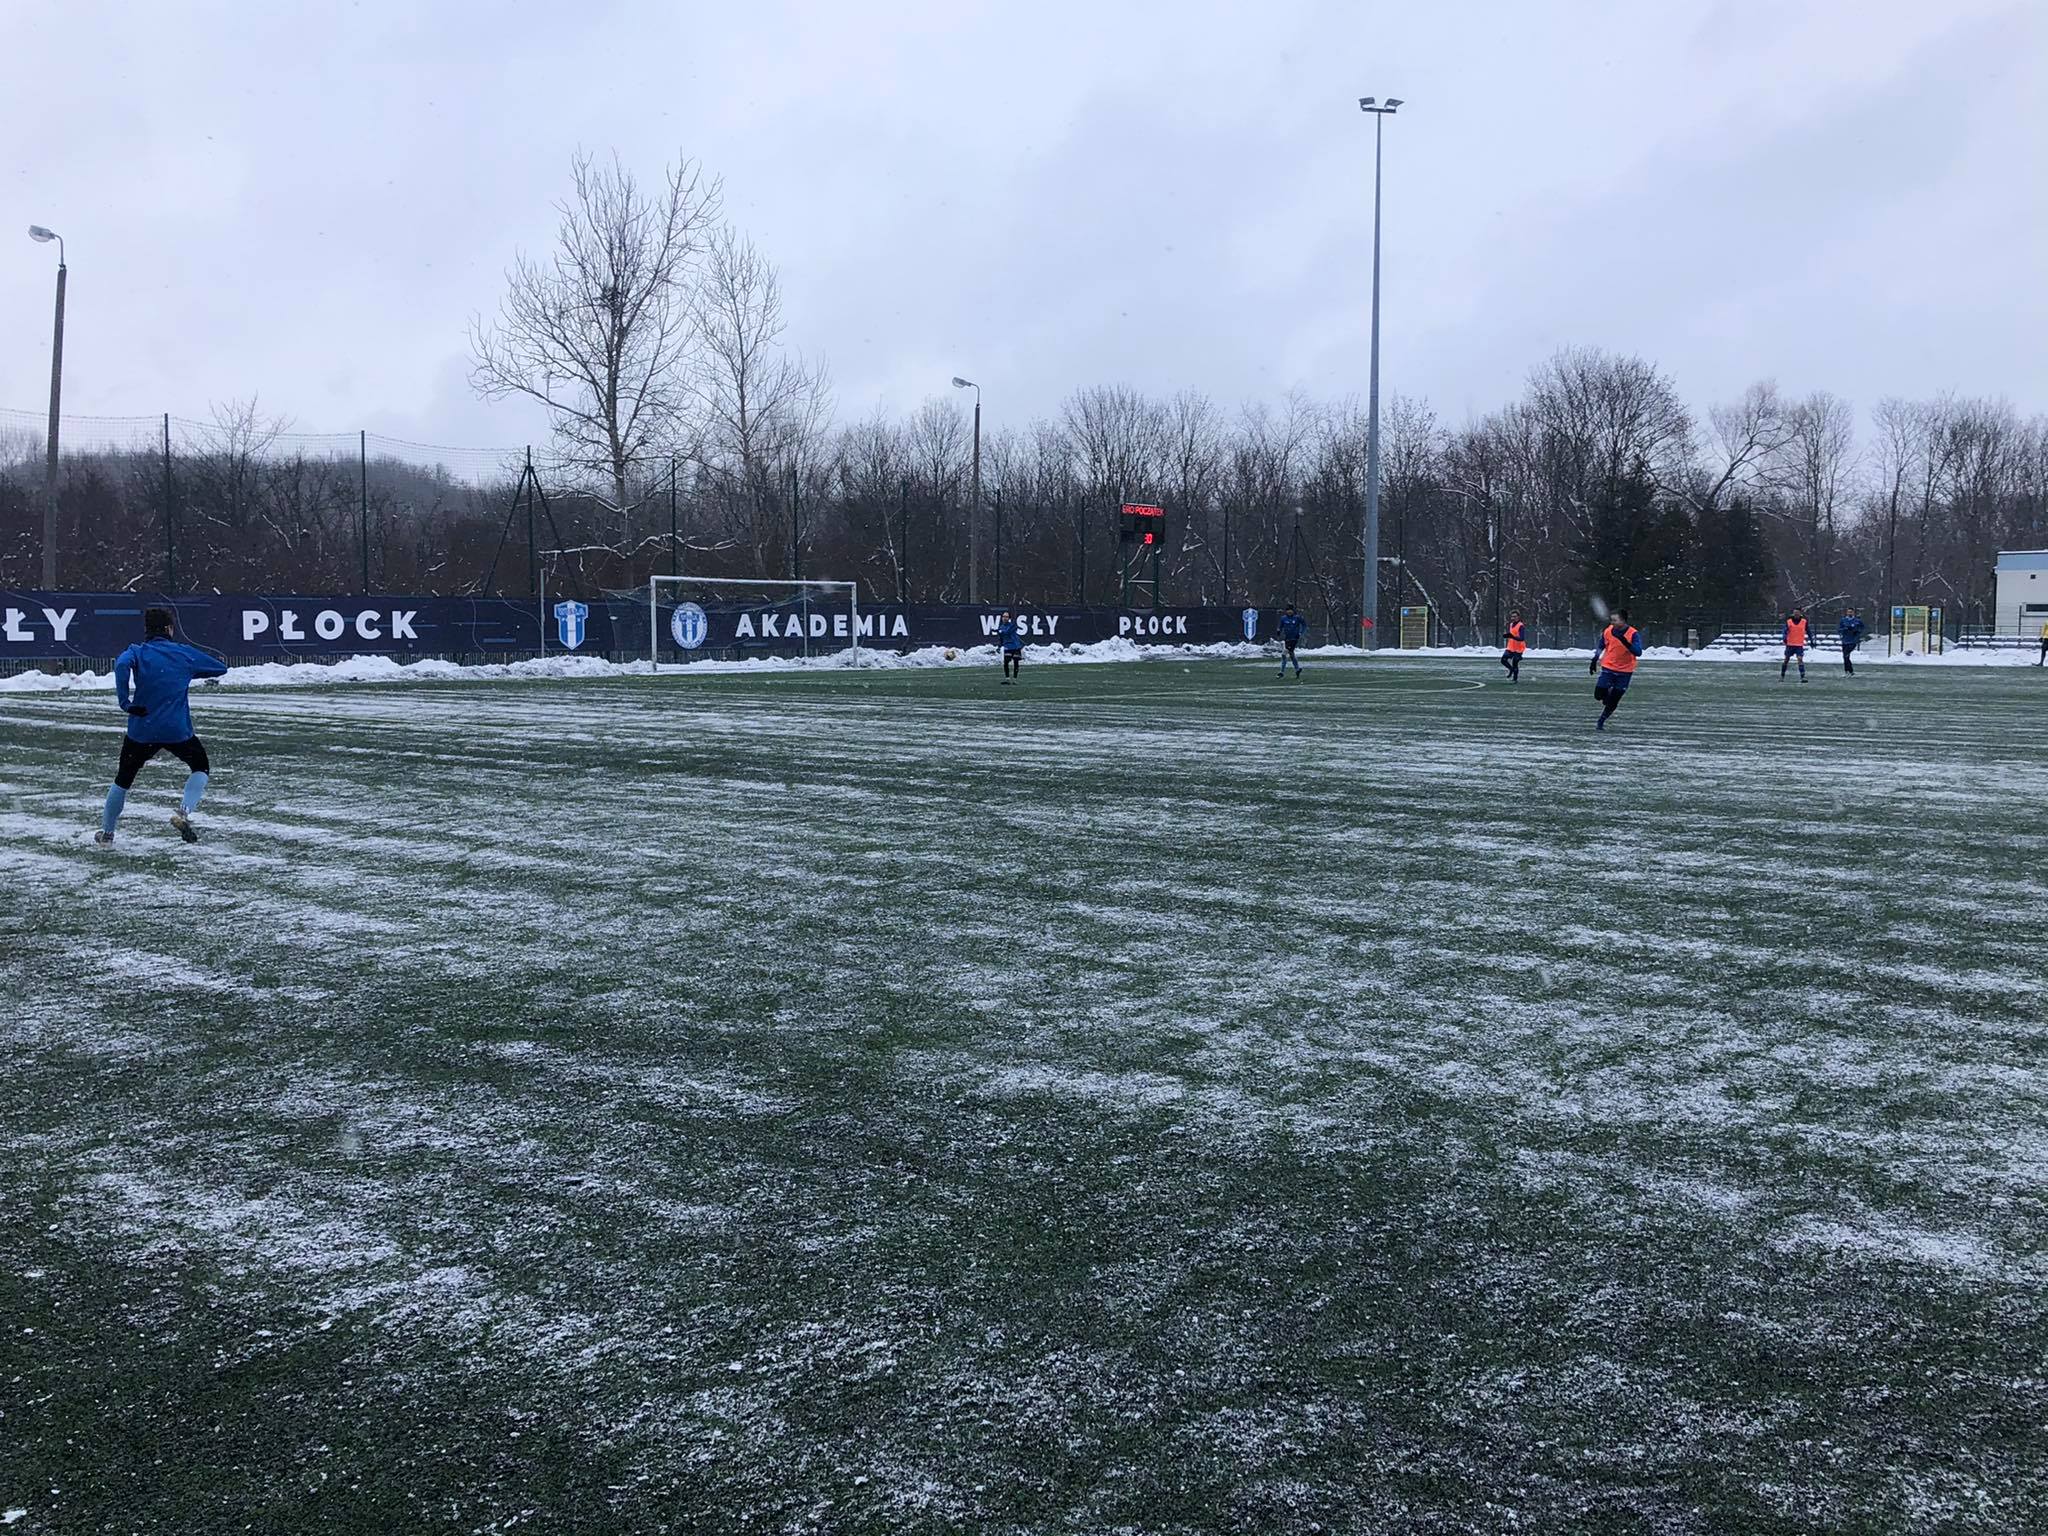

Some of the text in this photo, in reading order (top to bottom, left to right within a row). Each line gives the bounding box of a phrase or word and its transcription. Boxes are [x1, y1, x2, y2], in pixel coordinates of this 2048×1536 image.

[242, 609, 418, 641] PŁOCK
[735, 613, 1187, 638] AKADEMIA WSŁY PŁOCK
